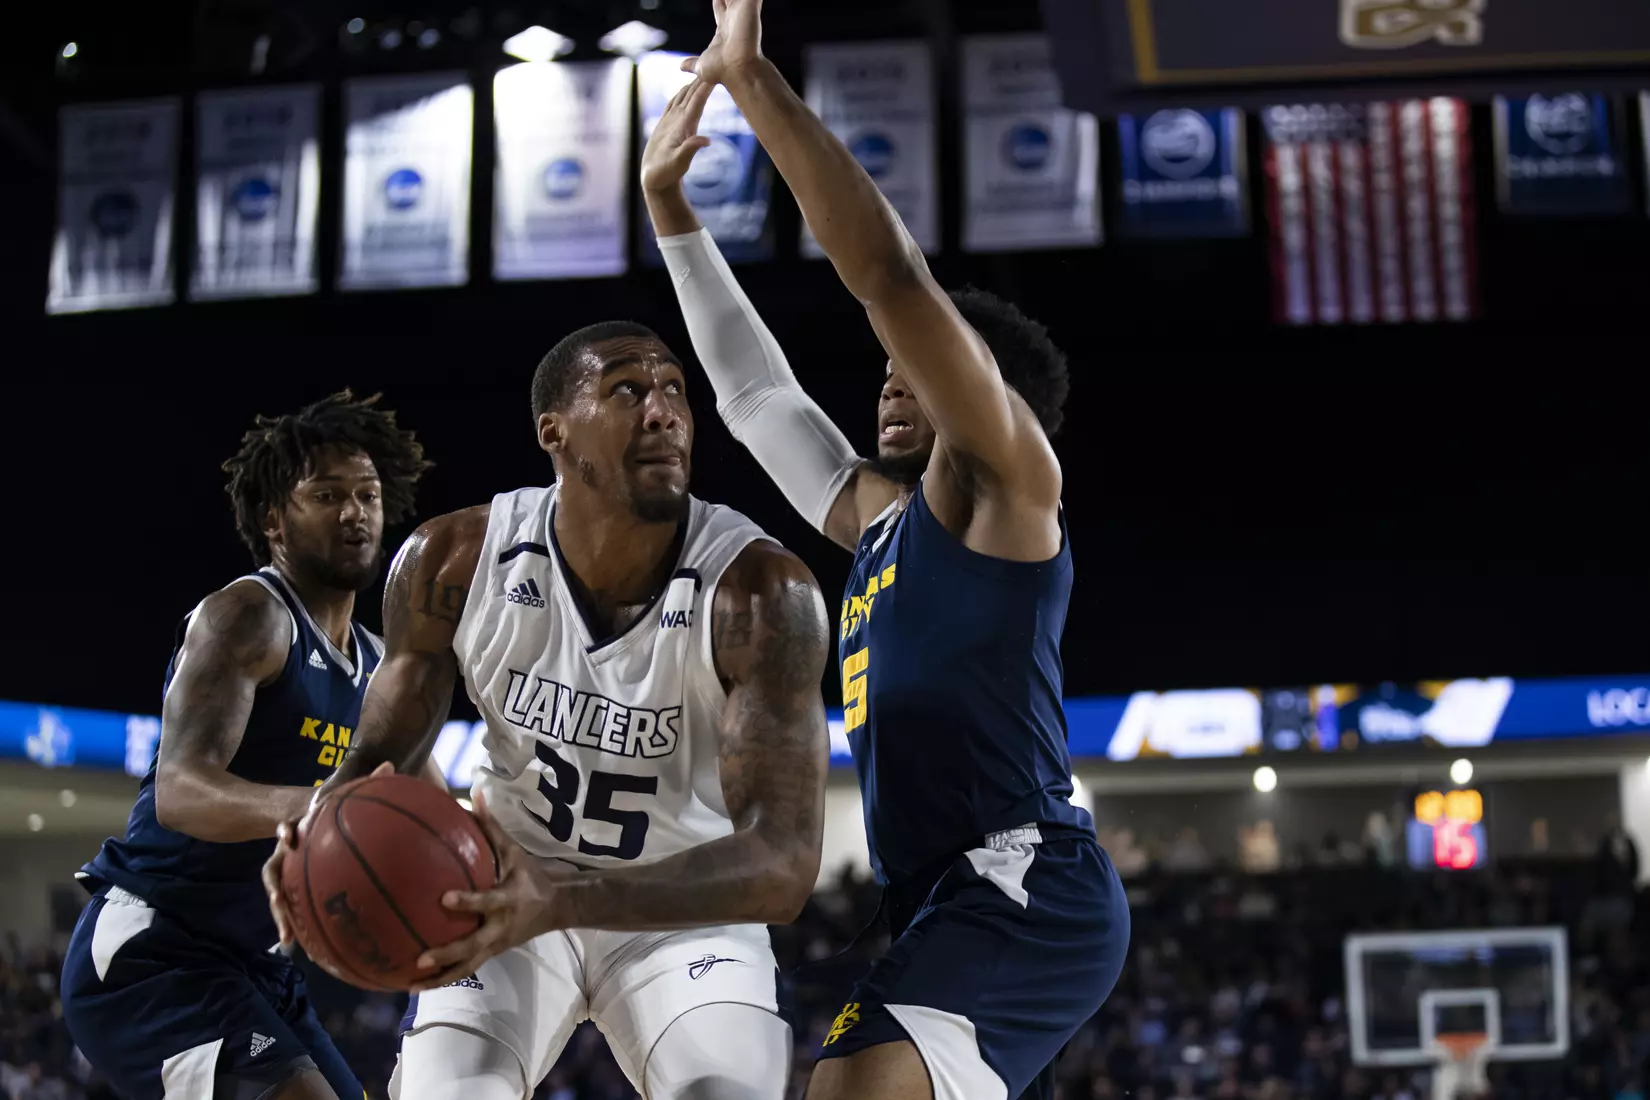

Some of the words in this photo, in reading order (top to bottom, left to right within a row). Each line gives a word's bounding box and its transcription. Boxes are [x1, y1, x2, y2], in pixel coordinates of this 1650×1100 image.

[507, 592, 545, 609] adidas
[502, 668, 682, 759] LANCERS
[1586, 688, 1650, 728] LOC
[300, 716, 352, 749] KAN
[317, 744, 346, 769] CI
[520, 739, 658, 861] 35
[1433, 822, 1478, 871] 15
[250, 1036, 276, 1057] adidas
